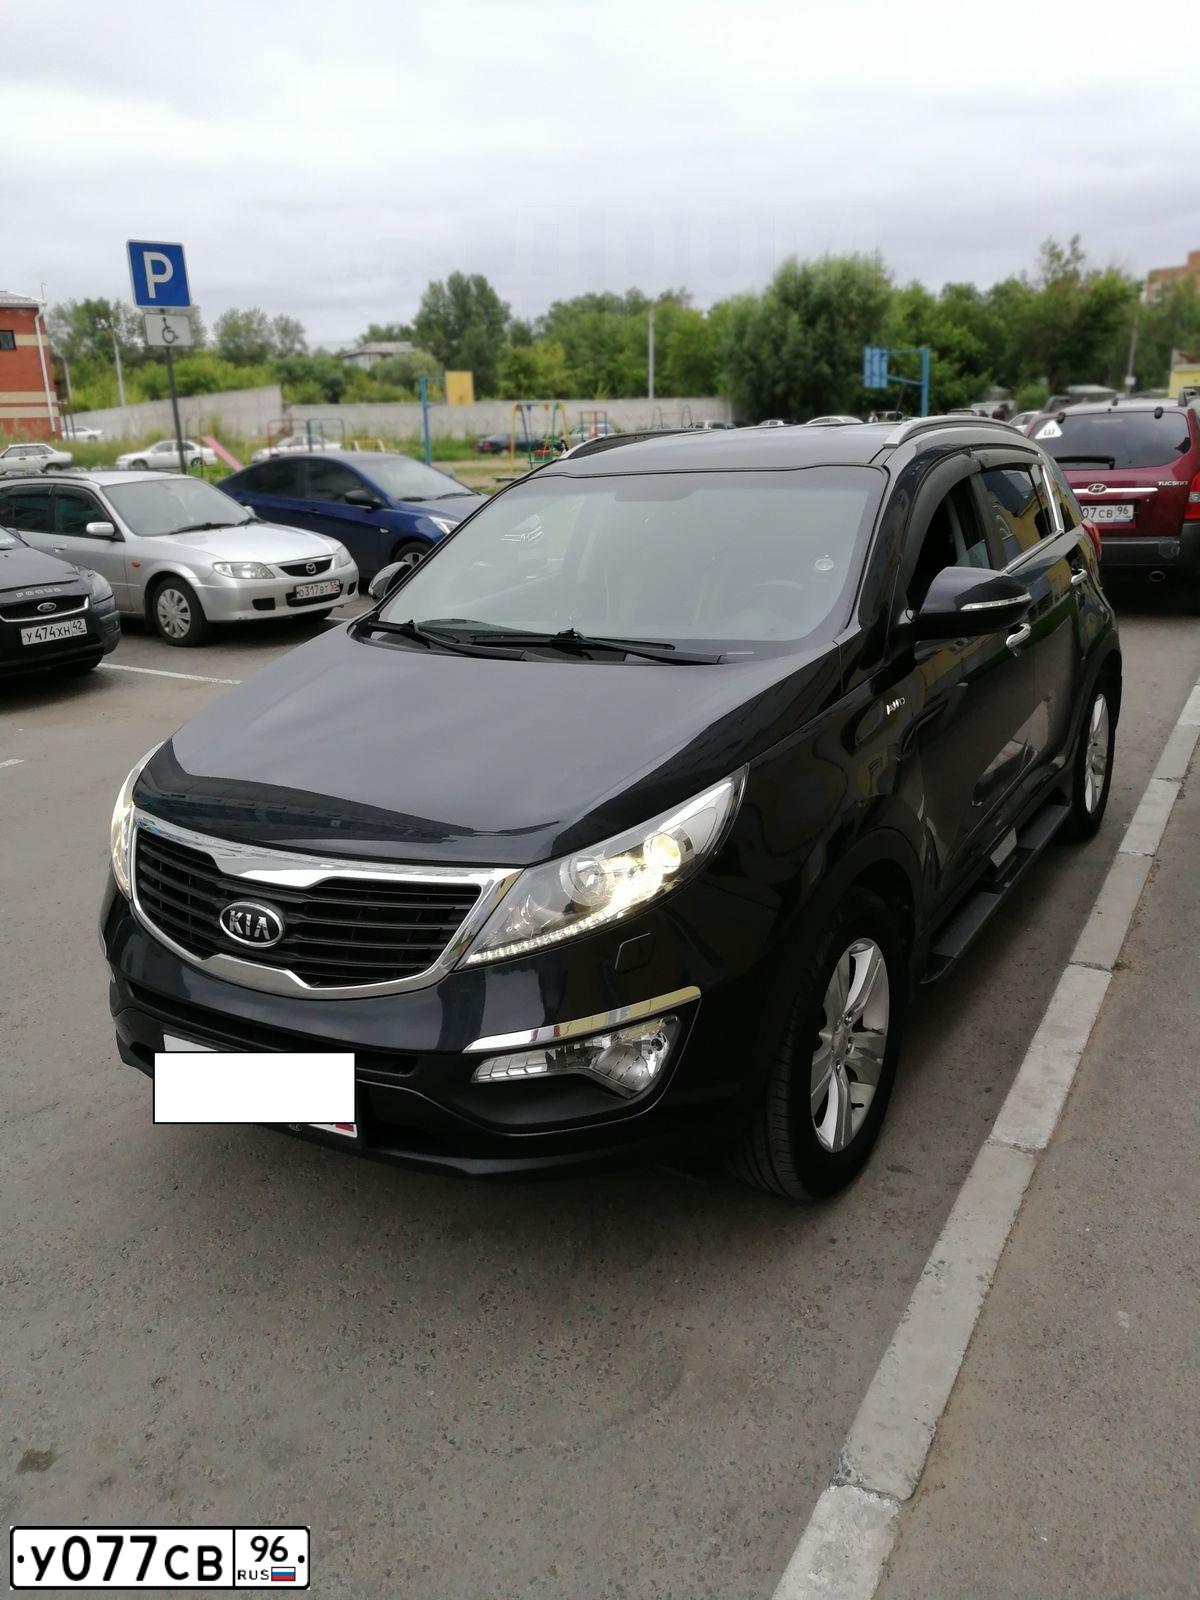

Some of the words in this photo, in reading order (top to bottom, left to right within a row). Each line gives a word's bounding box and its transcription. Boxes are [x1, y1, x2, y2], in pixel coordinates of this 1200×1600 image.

[143, 251, 174, 299] P
[1117, 506, 1129, 515] 96
[72, 620, 83, 631] 42
[229, 909, 271, 940] KIA
